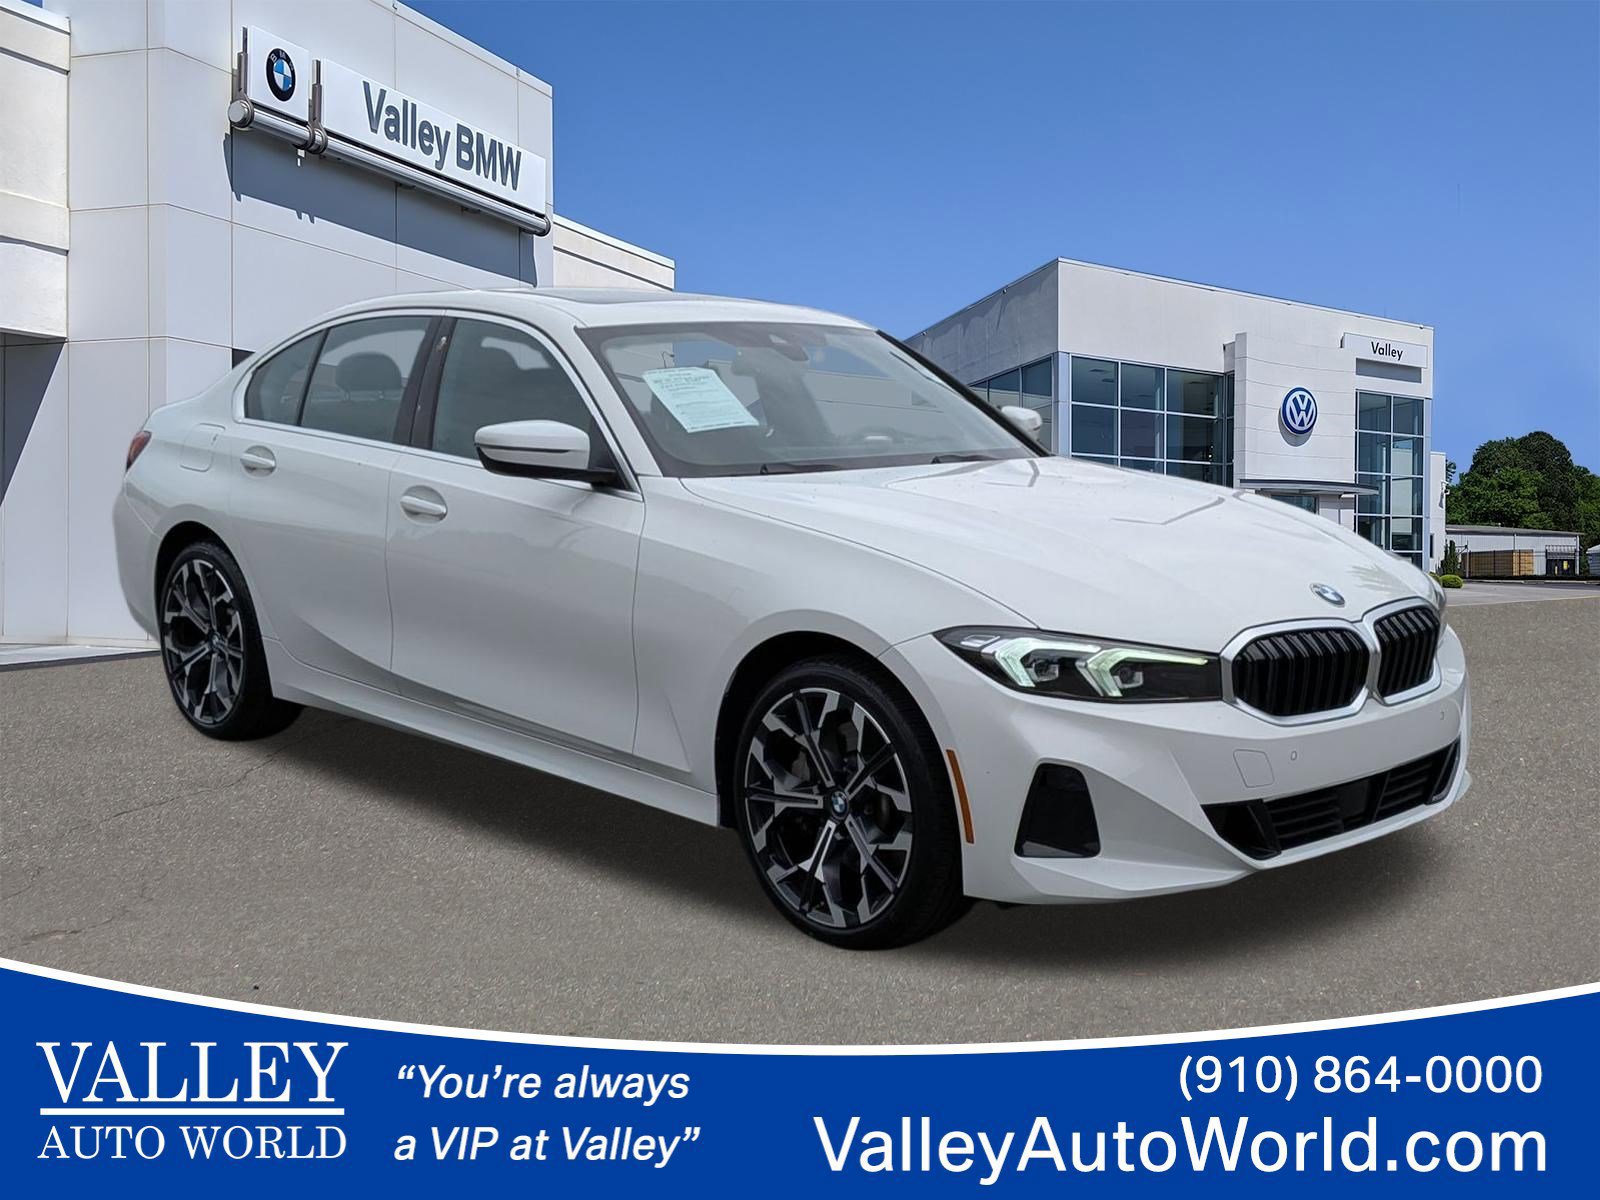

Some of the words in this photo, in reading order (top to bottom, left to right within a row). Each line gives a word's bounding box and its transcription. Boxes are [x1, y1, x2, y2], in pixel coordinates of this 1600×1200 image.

[362, 80, 451, 171] Valley
[456, 123, 522, 191] BMW
[1371, 341, 1403, 361] Valley
